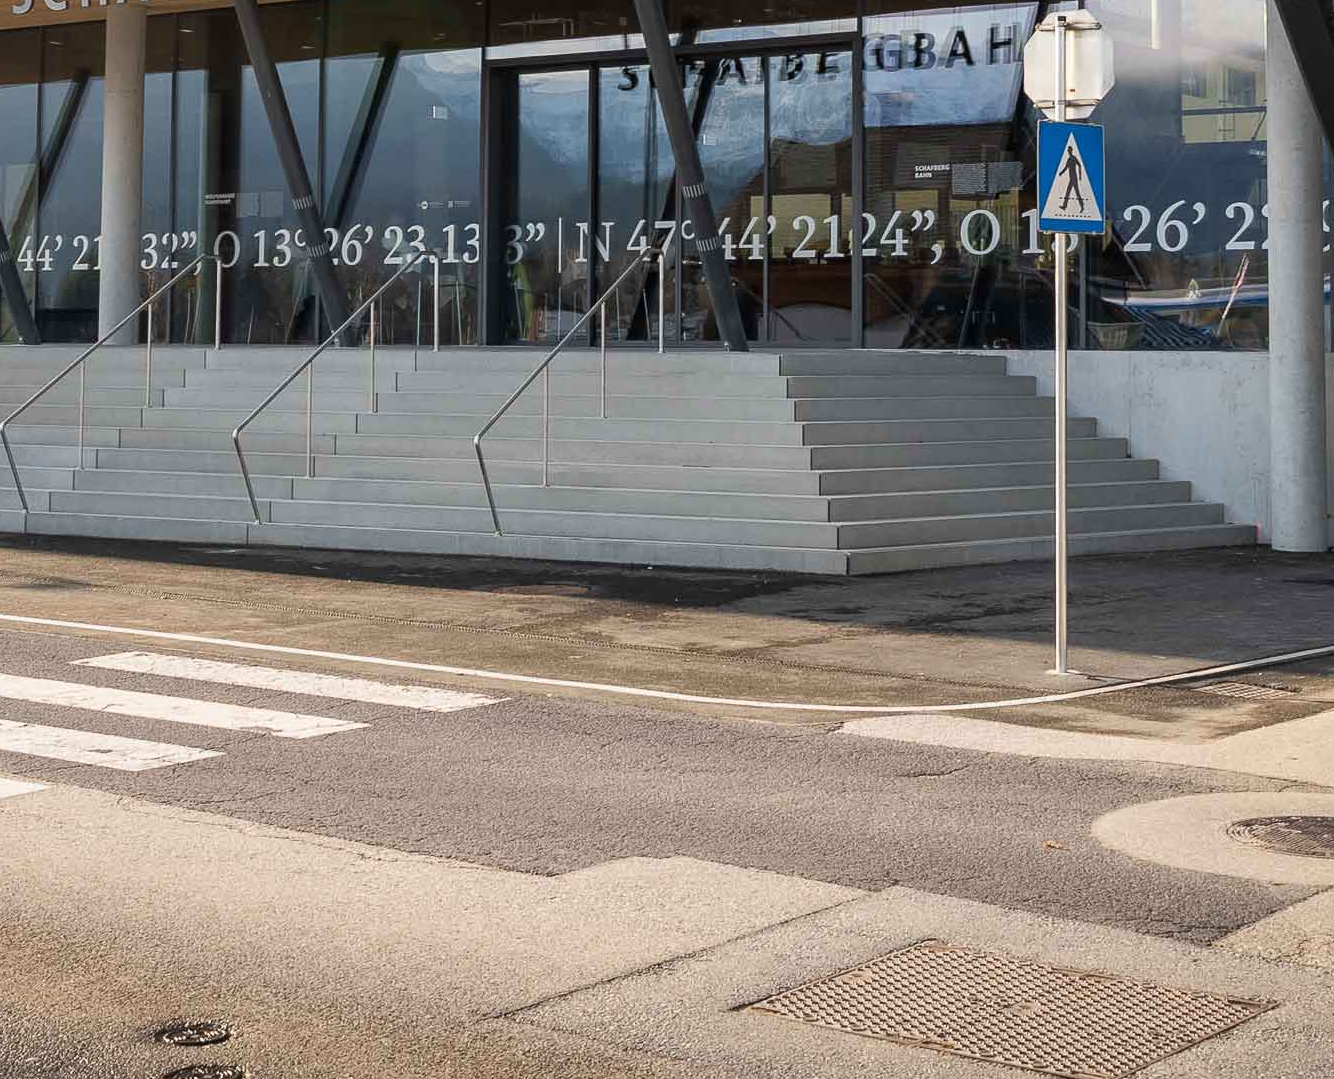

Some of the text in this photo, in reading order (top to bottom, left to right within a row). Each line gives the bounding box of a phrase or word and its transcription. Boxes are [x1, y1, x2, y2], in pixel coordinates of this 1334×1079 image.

[214, 230, 240, 268] O
[575, 222, 615, 263] N
[626, 218, 696, 263] 47°
[960, 209, 1001, 255] O
[1123, 199, 1206, 253] 26’
